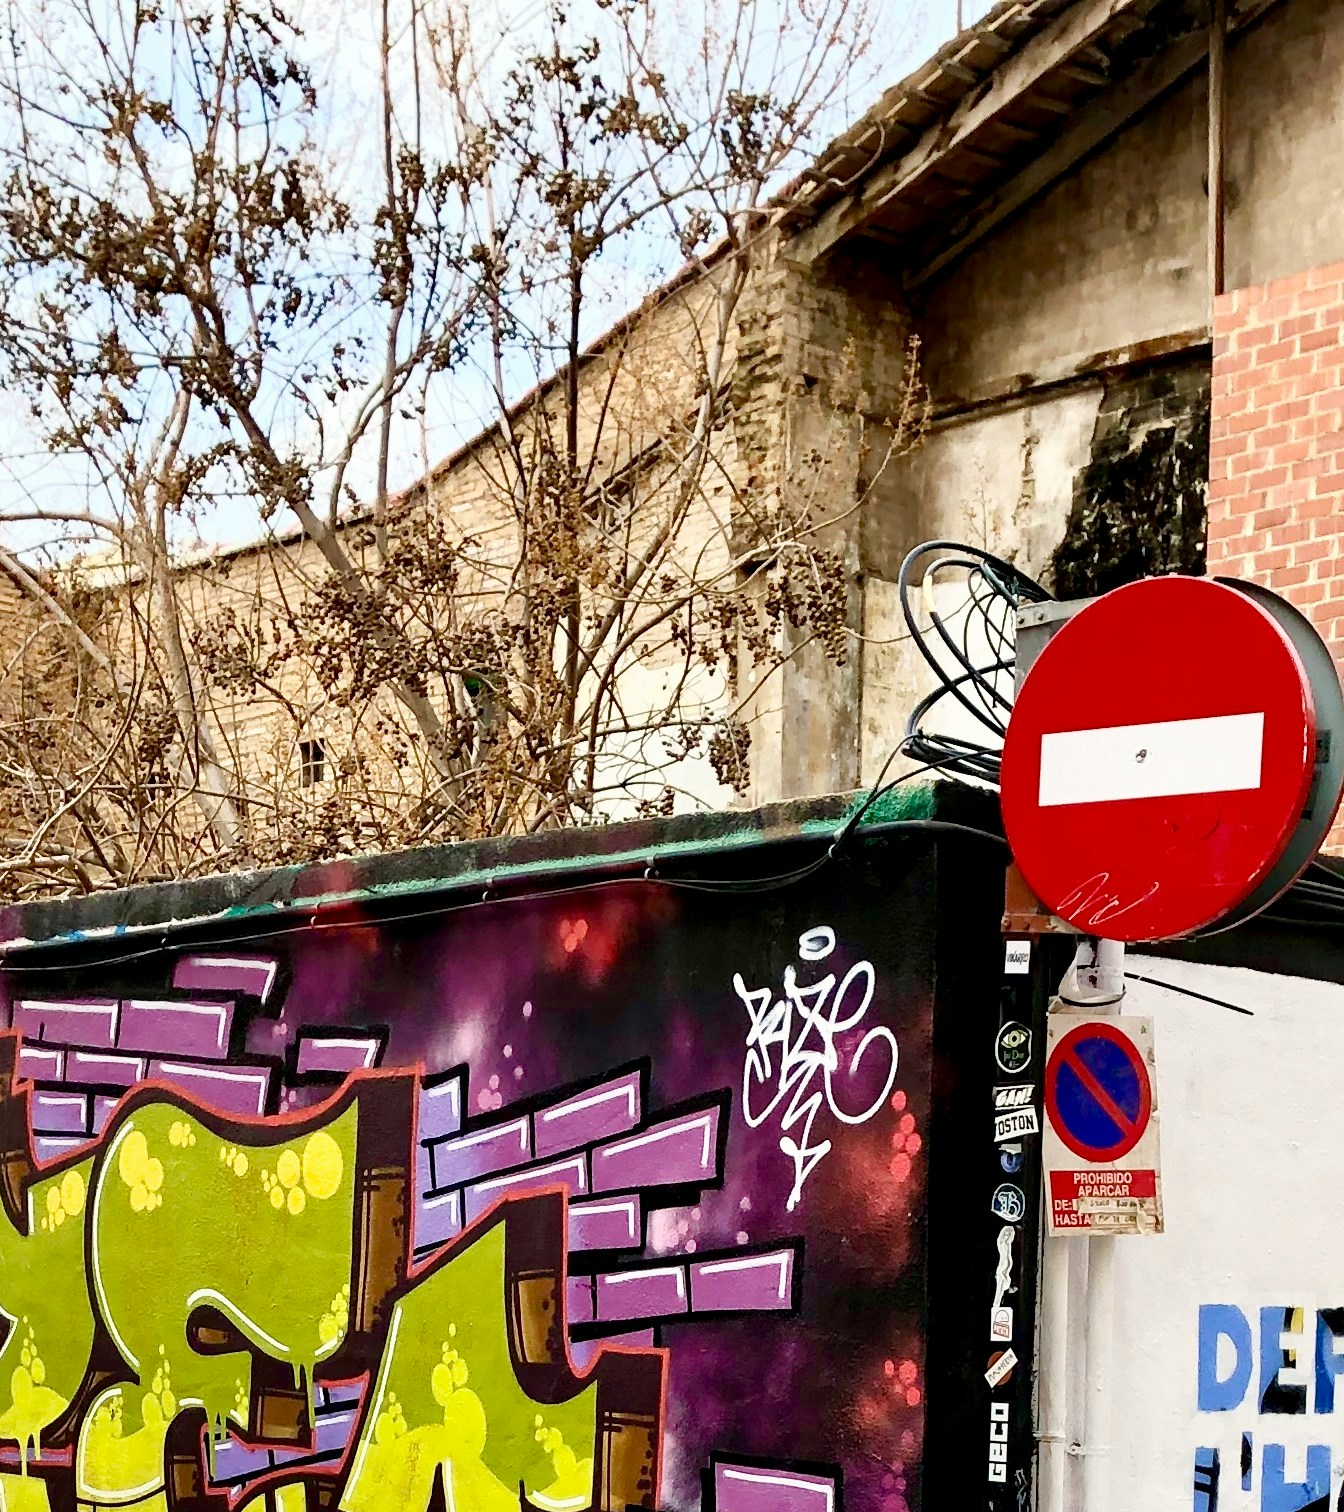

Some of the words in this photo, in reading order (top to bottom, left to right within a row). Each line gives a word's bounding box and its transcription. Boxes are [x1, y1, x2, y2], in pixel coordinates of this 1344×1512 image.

[996, 1114, 1035, 1136] OSTON
[1073, 1172, 1133, 1185] PROHIBIDO
[1078, 1184, 1130, 1197] APARCAR
[1055, 1213, 1092, 1226] HASTA
